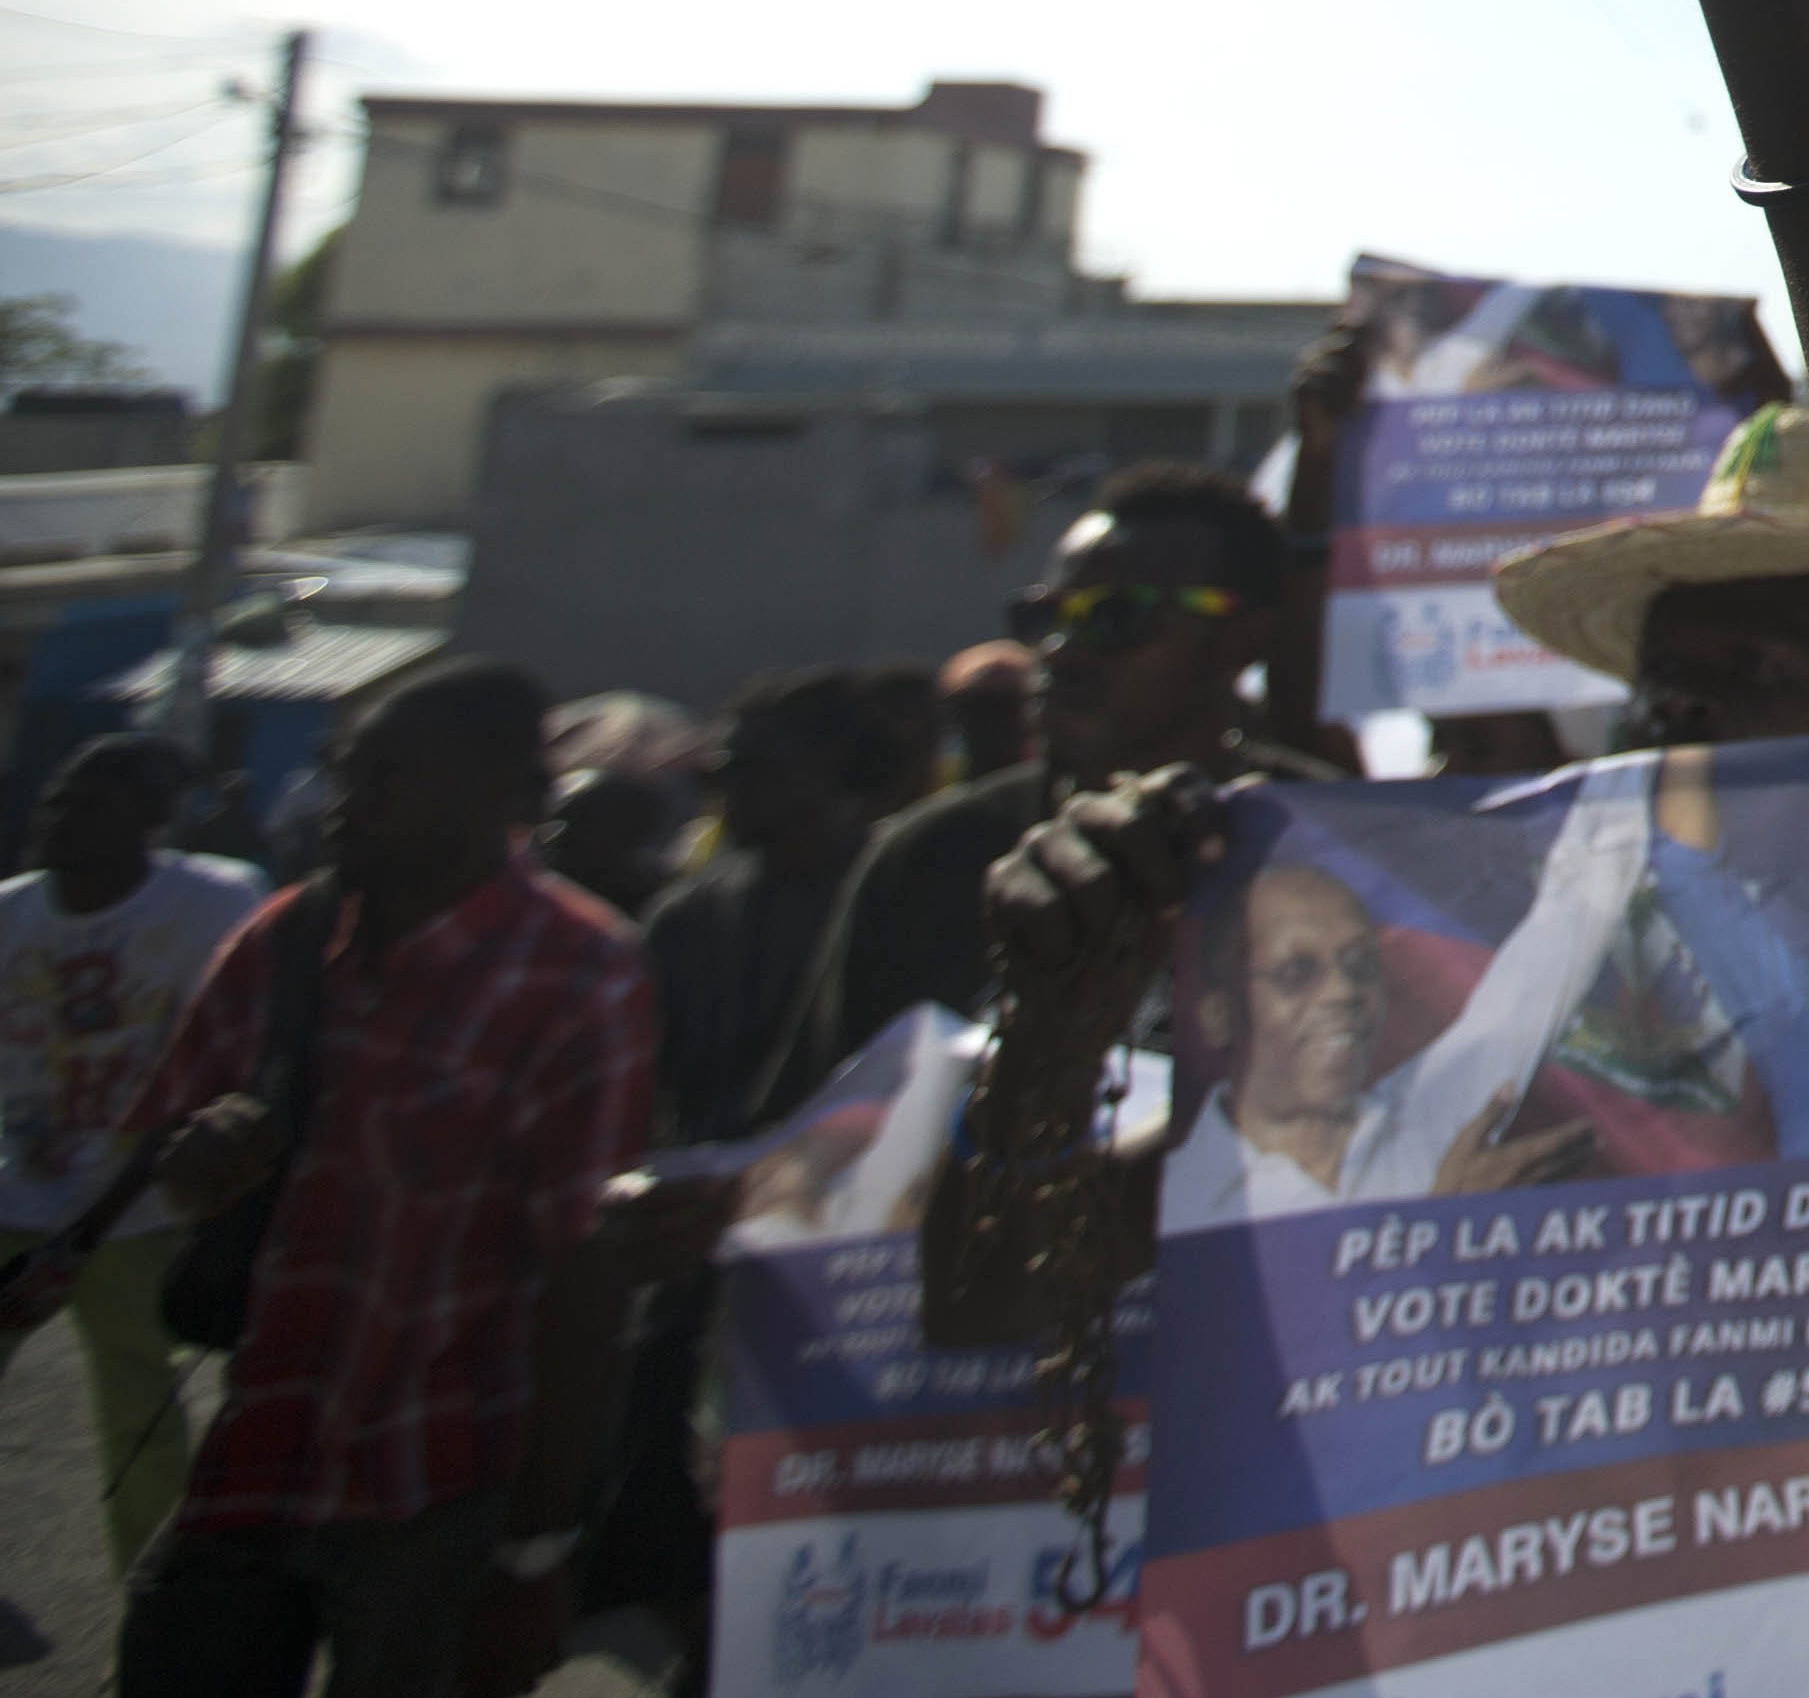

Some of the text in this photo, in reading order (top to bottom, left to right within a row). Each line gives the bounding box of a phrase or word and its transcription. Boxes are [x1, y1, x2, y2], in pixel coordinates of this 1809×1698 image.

[1332, 1212, 1439, 1278] PÈP
[1454, 1214, 1519, 1261] LA
[1534, 1206, 1608, 1255] AK
[1627, 1189, 1768, 1248] TITID
[1353, 1279, 1497, 1344] VOTE
[1513, 1250, 1693, 1325] DOKTÈ
[1278, 1370, 1344, 1418] AK
[1354, 1348, 1470, 1401] TOUT
[1478, 1324, 1660, 1380] KANDIDA
[1667, 1314, 1796, 1358] FANMI
[1424, 1389, 1517, 1466] BÒ
[1534, 1380, 1652, 1445] TAB
[1672, 1373, 1744, 1426] LA
[1242, 1568, 1367, 1654] DR.
[1389, 1505, 1677, 1612] MARYSE
